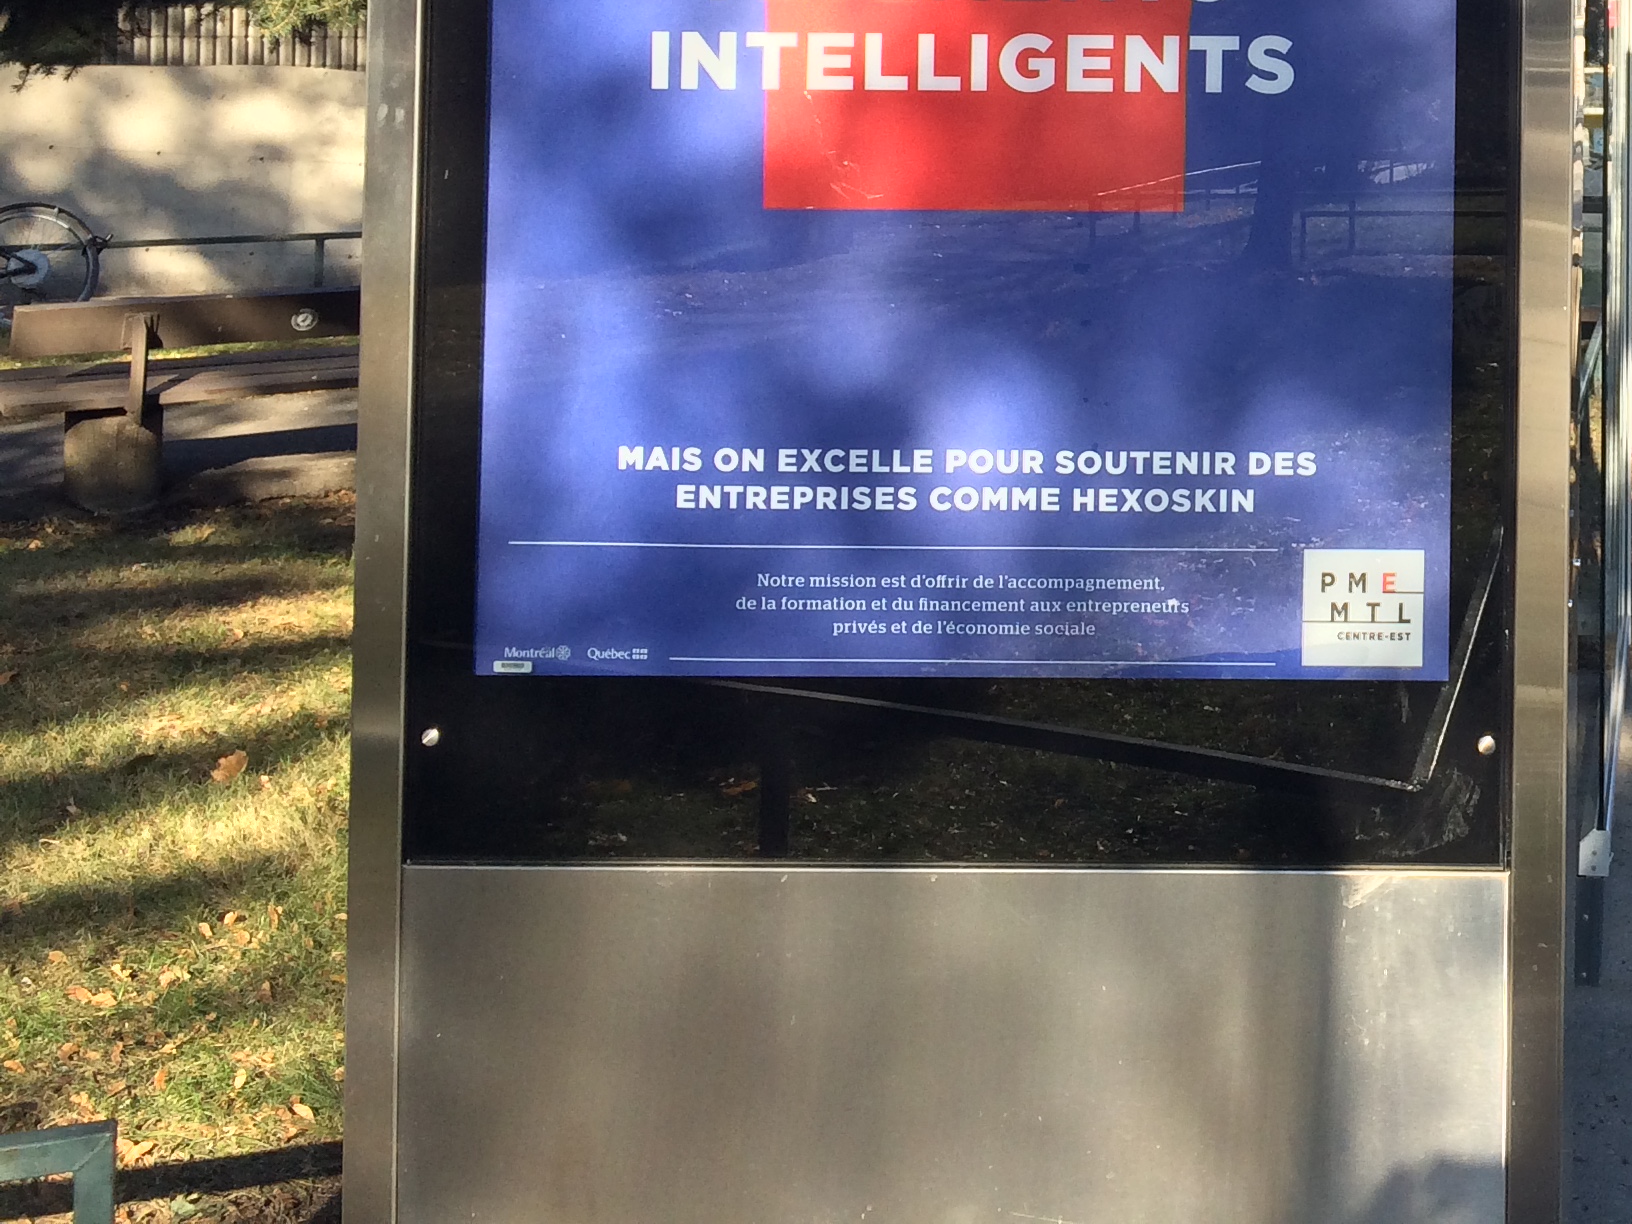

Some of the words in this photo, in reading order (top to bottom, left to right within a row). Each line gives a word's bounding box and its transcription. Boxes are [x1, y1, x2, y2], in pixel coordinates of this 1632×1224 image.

[650, 30, 1296, 95] INTELLIGENTS
[618, 445, 702, 472] MAIS
[713, 447, 765, 472] ON
[777, 448, 933, 474] EXCELLE
[945, 449, 1044, 475] POUR
[1055, 450, 1236, 476] SOUTENIR
[1248, 451, 1317, 477] DES
[676, 484, 918, 511] ENTREPRISES
[929, 485, 1060, 512] COMME
[1072, 487, 1256, 514] HEXOSKIN
[757, 573, 805, 588] Notre
[809, 573, 877, 588] mission
[881, 574, 907, 588] est
[910, 573, 969, 589] d'offrir
[972, 574, 995, 589] de
[998, 574, 1166, 593] l'accompagnement,
[735, 596, 757, 610] de
[760, 596, 777, 611] la
[780, 596, 867, 611] formation
[870, 597, 888, 611] et
[891, 596, 914, 611] du
[918, 596, 1026, 612] financement
[1029, 600, 1062, 613] aux
[832, 619, 887, 637] privés
[890, 620, 908, 634] et
[911, 620, 933, 635] de
[936, 620, 1031, 636] l'économie
[1034, 621, 1096, 636] sociale
[1337, 631, 1411, 641] CENTRE-EST
[587, 647, 631, 660] Québec
